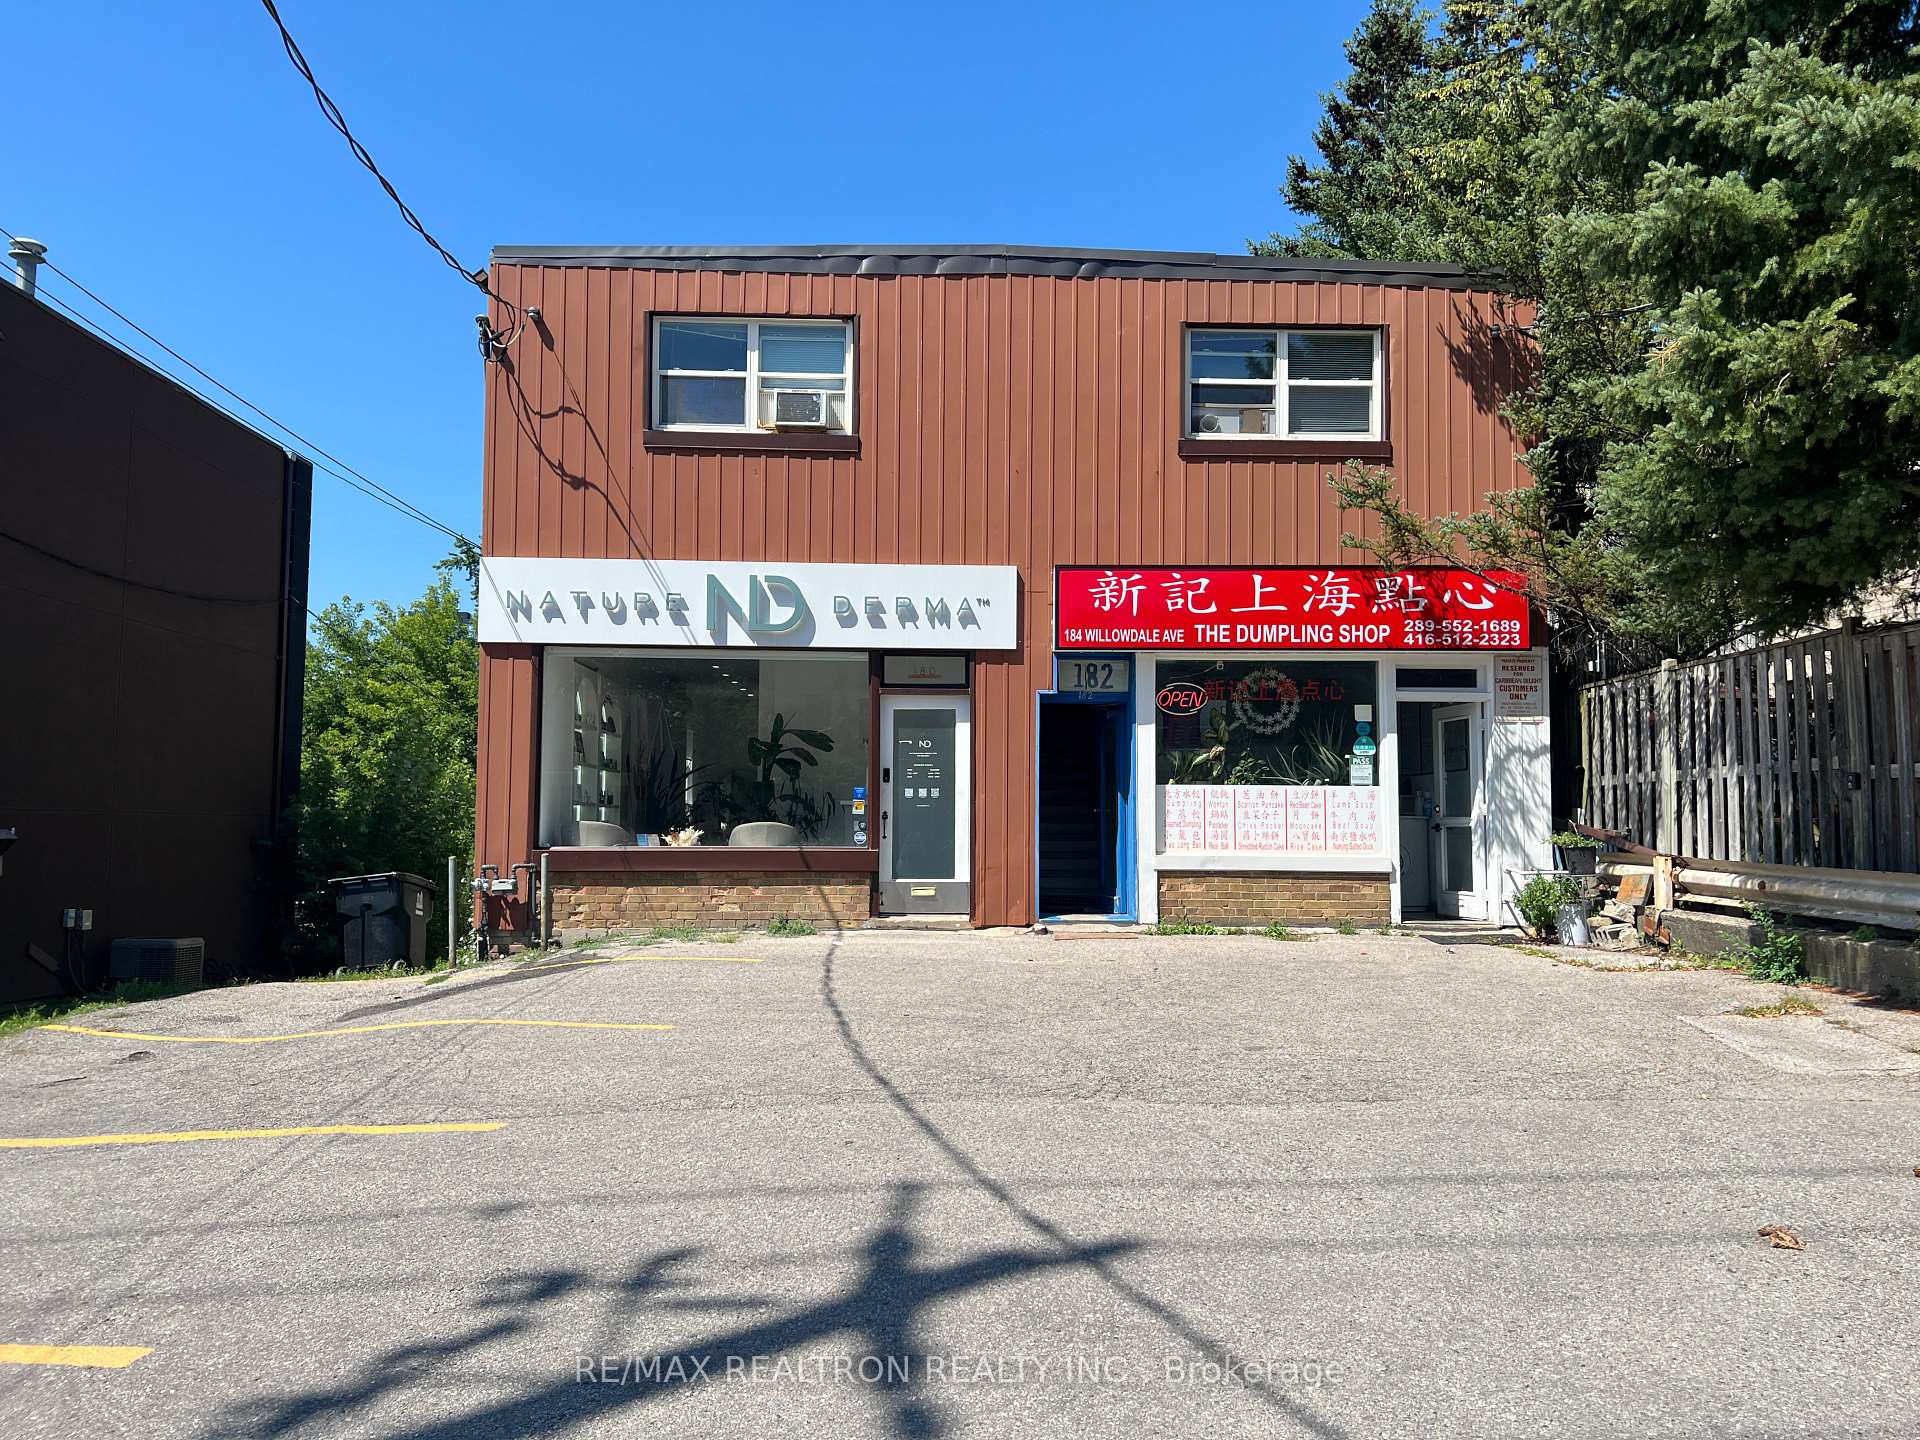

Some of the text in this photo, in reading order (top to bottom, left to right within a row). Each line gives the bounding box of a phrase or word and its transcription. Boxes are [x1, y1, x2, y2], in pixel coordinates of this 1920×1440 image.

[1087, 570, 1497, 617] 新記上海點心
[506, 590, 683, 614] NATURE
[706, 573, 804, 633] ND
[1194, 624, 1391, 643] THE DUMPLING SHOP
[1403, 619, 1521, 632] 289-552-1689
[1064, 628, 1185, 643] 184 WILLOWDALE AVE
[1403, 633, 1521, 645] 416-512-2323
[1073, 663, 1114, 690] 182
[1158, 691, 1204, 708] OPEN
[1352, 757, 1370, 765] PASS
